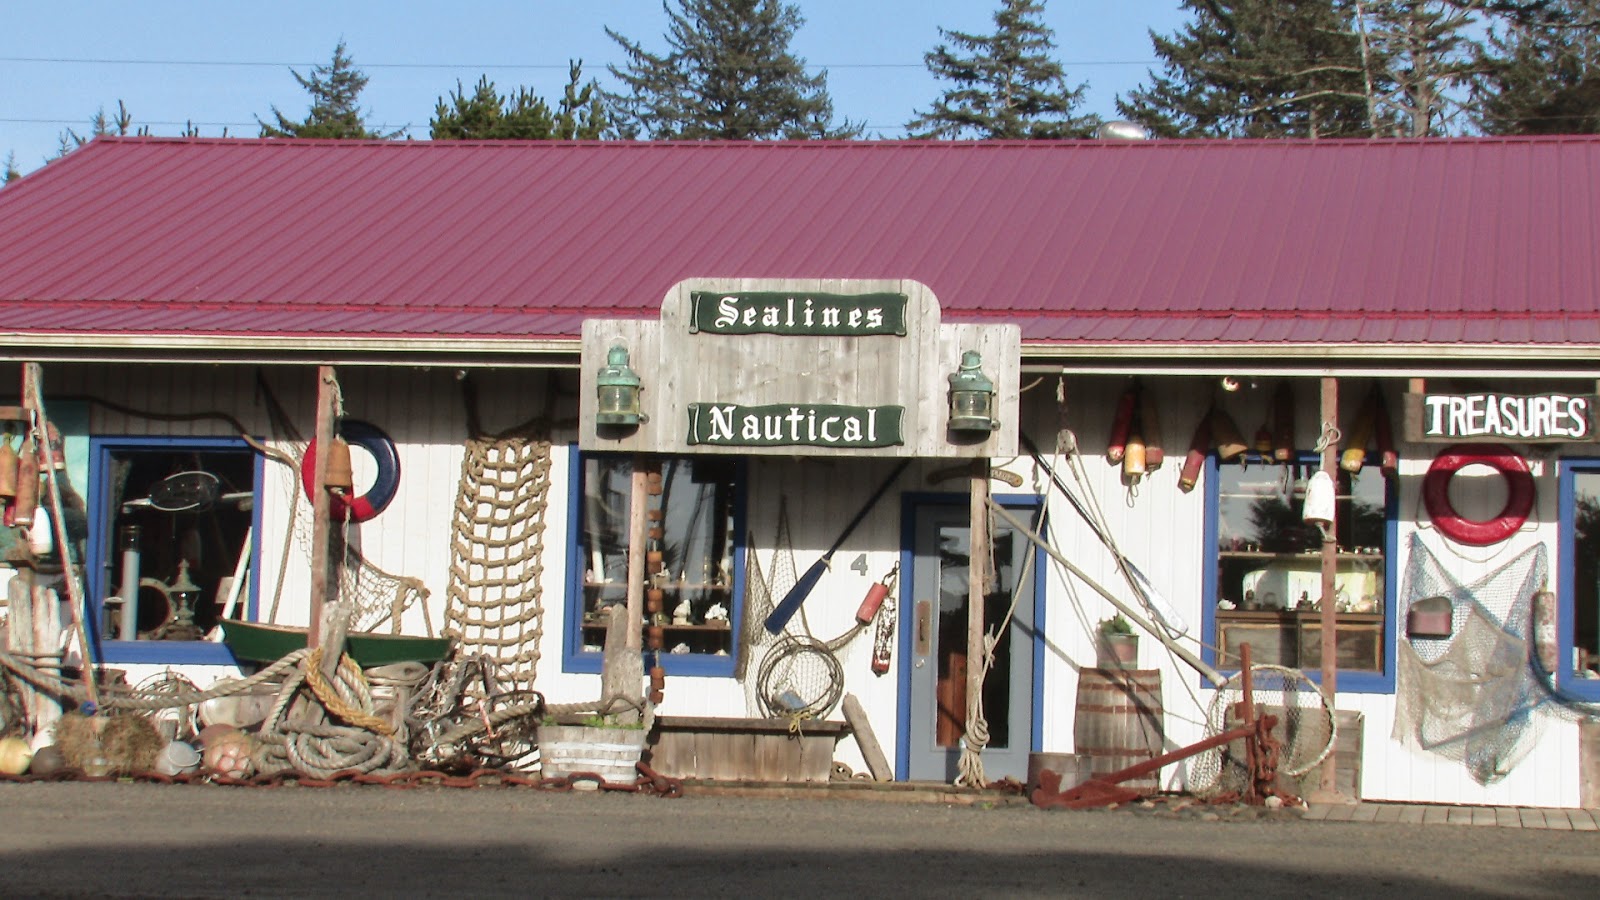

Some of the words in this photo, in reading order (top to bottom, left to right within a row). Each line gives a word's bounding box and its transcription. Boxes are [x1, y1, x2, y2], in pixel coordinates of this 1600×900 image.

[714, 297, 883, 328] Sealines
[707, 405, 877, 442] Nautical
[1425, 395, 1587, 437] TREASURES
[850, 553, 868, 576] 4
